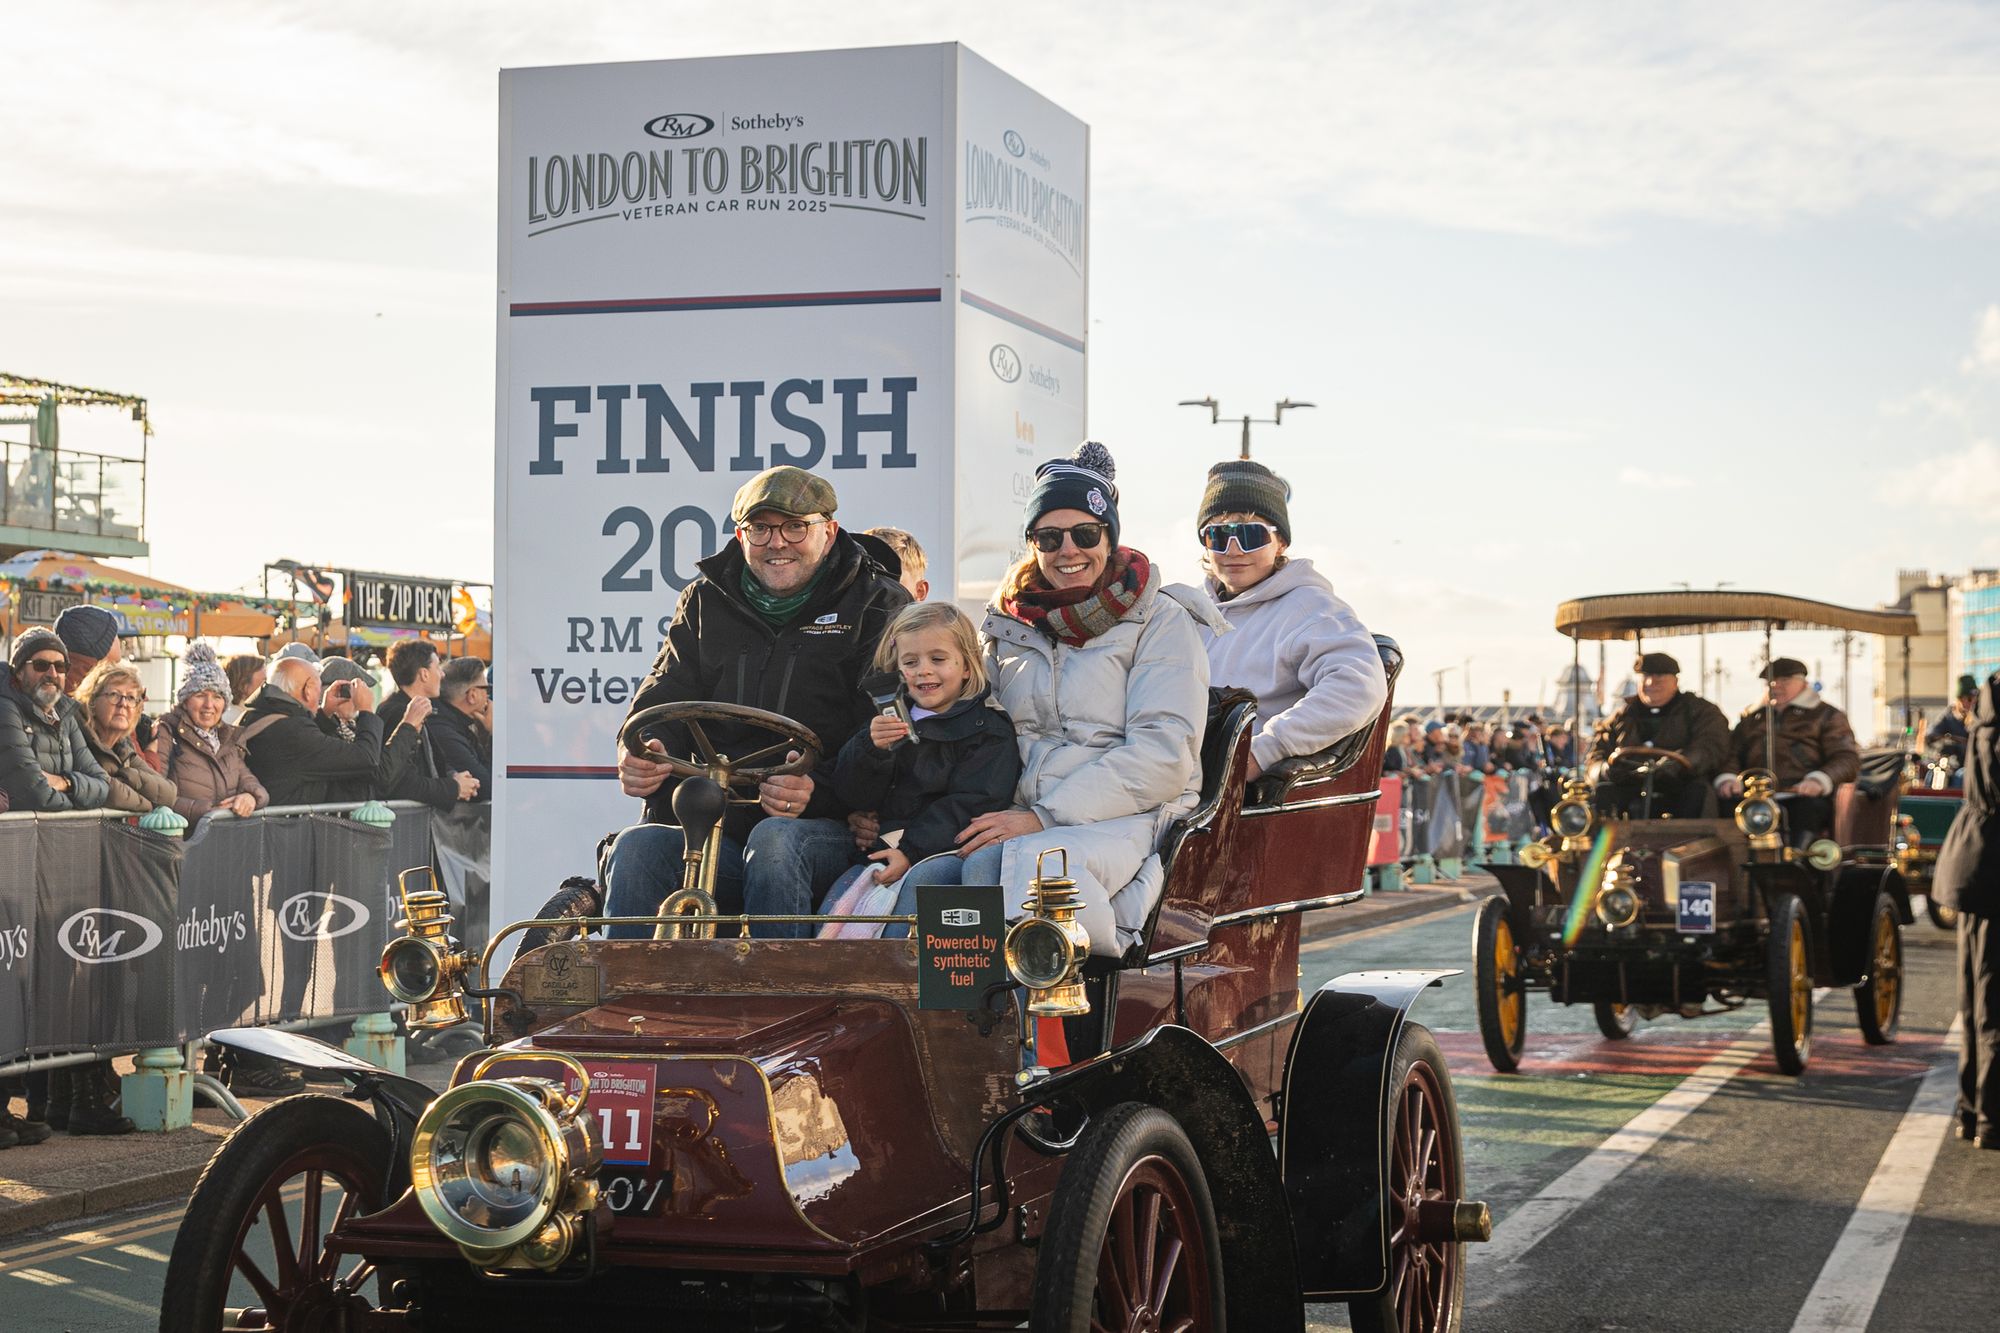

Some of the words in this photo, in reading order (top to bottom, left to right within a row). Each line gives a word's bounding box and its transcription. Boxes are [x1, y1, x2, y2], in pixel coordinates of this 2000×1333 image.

[731, 113, 805, 131] Sotheby's
[528, 149, 673, 224] LONDON
[682, 147, 729, 195] TO
[740, 136, 927, 207] BRIGHTON
[622, 201, 698, 220] VETERAN
[706, 199, 739, 212] CAR
[746, 199, 780, 211] RUN
[788, 199, 827, 213] 2025
[966, 140, 1013, 213] LONDON
[1015, 167, 1030, 218] TO
[1032, 176, 1083, 268] BRIGHTON
[529, 376, 918, 476] FINISH
[601, 505, 734, 593] 20
[24, 593, 44, 618] KIT
[357, 580, 386, 621] THE
[389, 583, 412, 622] ZIP
[415, 585, 452, 625] DECK
[566, 616, 643, 653] RM
[967, 912, 974, 923] 8
[1680, 898, 1714, 917] 140
[177, 903, 247, 954] otheby's
[926, 934, 979, 950] Powered
[983, 934, 997, 953] by
[933, 953, 991, 971] synthetic
[950, 971, 974, 986] fuel
[600, 1078, 611, 1089] TO
[610, 1078, 646, 1094] BRIGHTON
